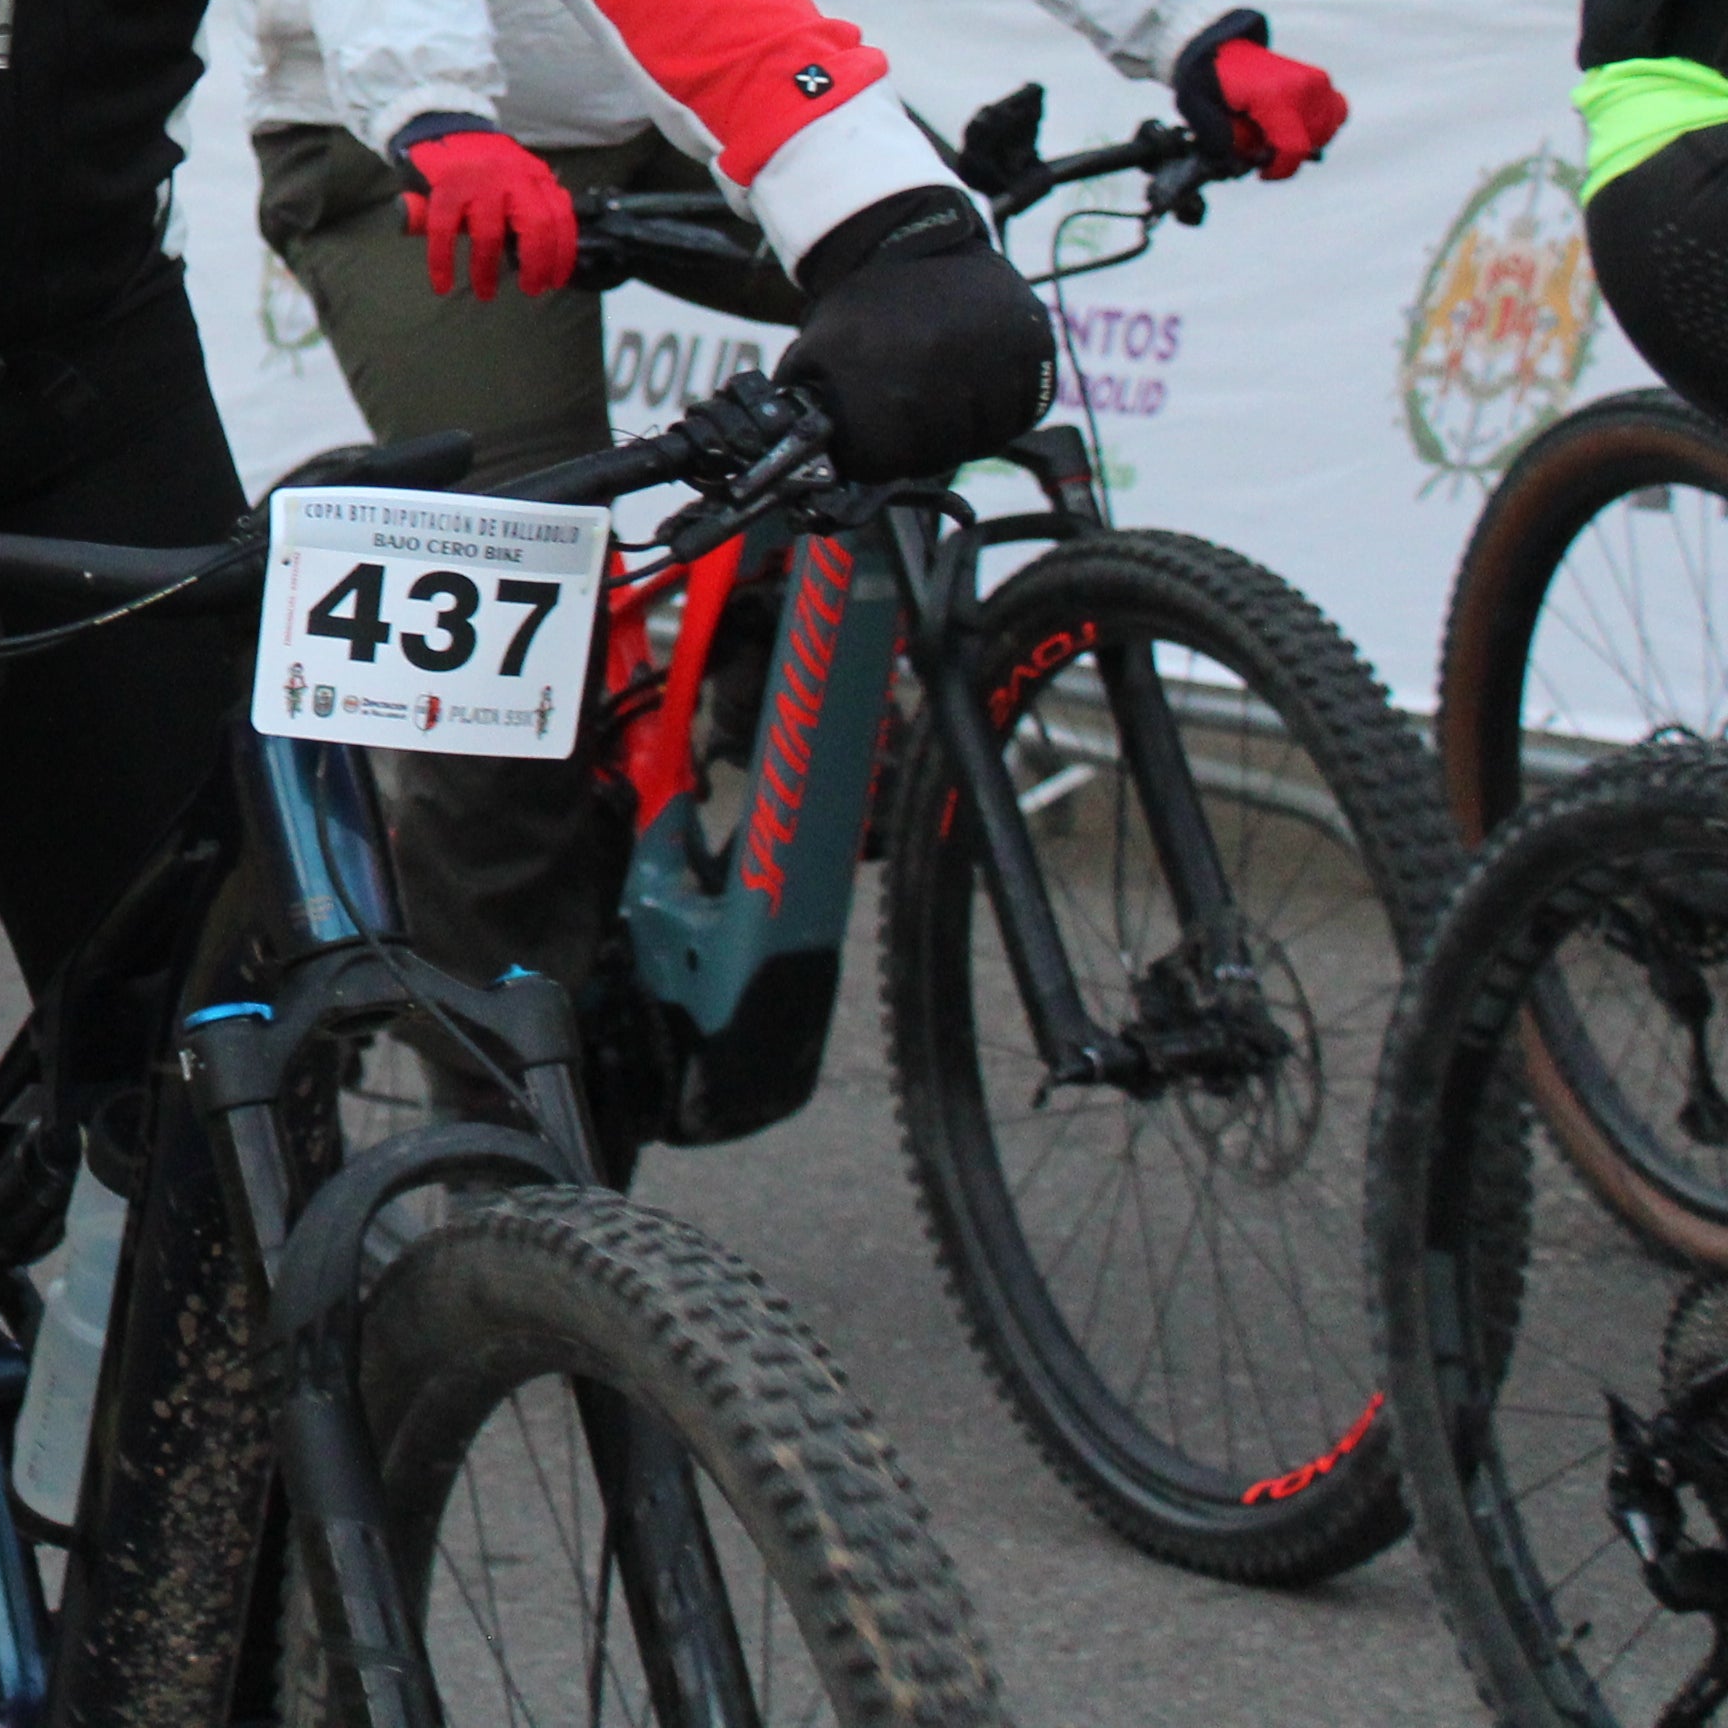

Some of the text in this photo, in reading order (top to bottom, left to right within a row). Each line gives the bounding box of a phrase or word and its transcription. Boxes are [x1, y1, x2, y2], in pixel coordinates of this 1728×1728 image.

[305, 503, 580, 544] COPA BTT DIPUTACIÓN DE VALLADOLID
[373, 532, 524, 564] BAJO CERO BIKE
[307, 562, 562, 678] 437
[741, 534, 854, 919] SPECIALIZED
